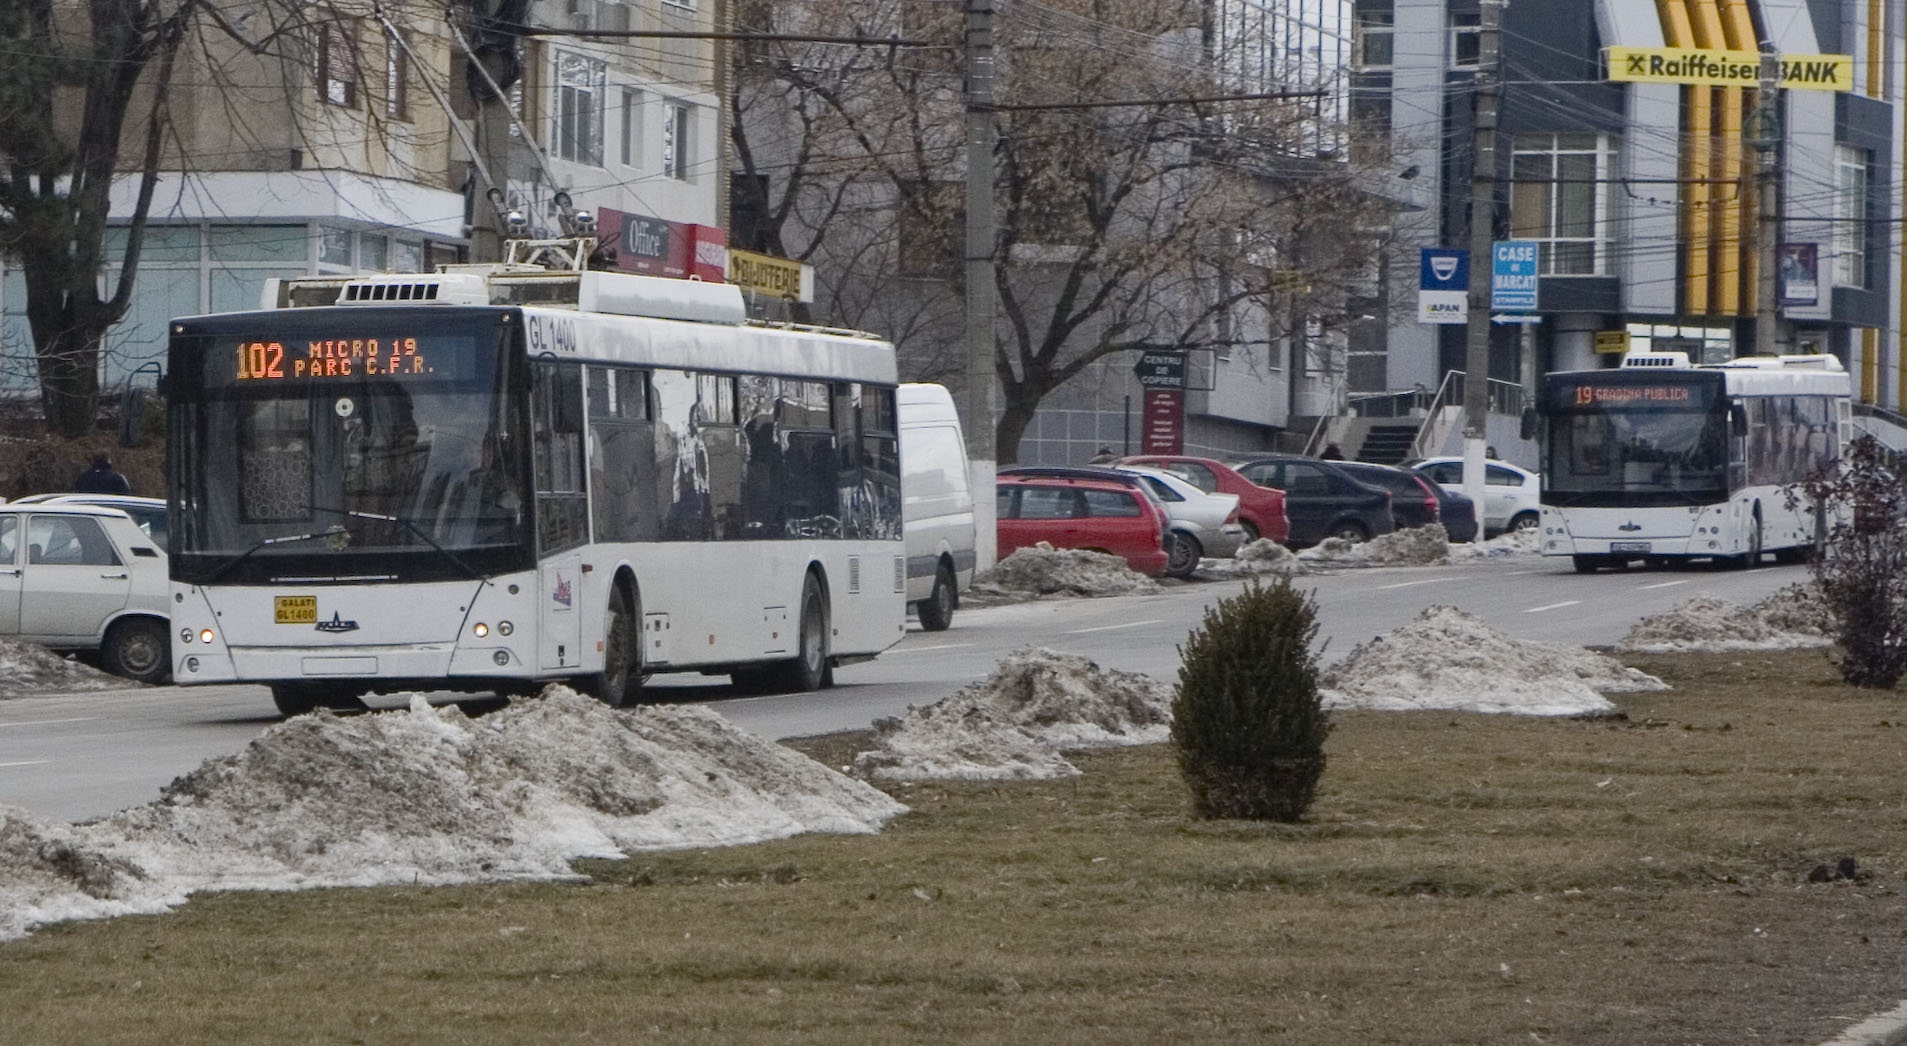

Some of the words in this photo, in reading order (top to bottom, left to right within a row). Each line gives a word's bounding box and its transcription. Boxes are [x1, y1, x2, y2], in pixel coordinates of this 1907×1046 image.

[629, 219, 661, 257] Office
[1498, 246, 1534, 261] CASE
[1494, 274, 1536, 289] MARCAT
[529, 315, 548, 350] GL
[549, 316, 577, 353] 1400
[236, 341, 284, 380] 102
[309, 338, 379, 360] MICRO
[392, 337, 417, 358] 19
[294, 357, 353, 378] PARC
[366, 355, 434, 377] C.F.R.
[1144, 355, 1182, 365] CENTRU
[1142, 375, 1183, 386] COPIERE
[1576, 386, 1592, 404] 19
[1644, 387, 1689, 401] PUBLICA
[280, 599, 315, 607] GALATI
